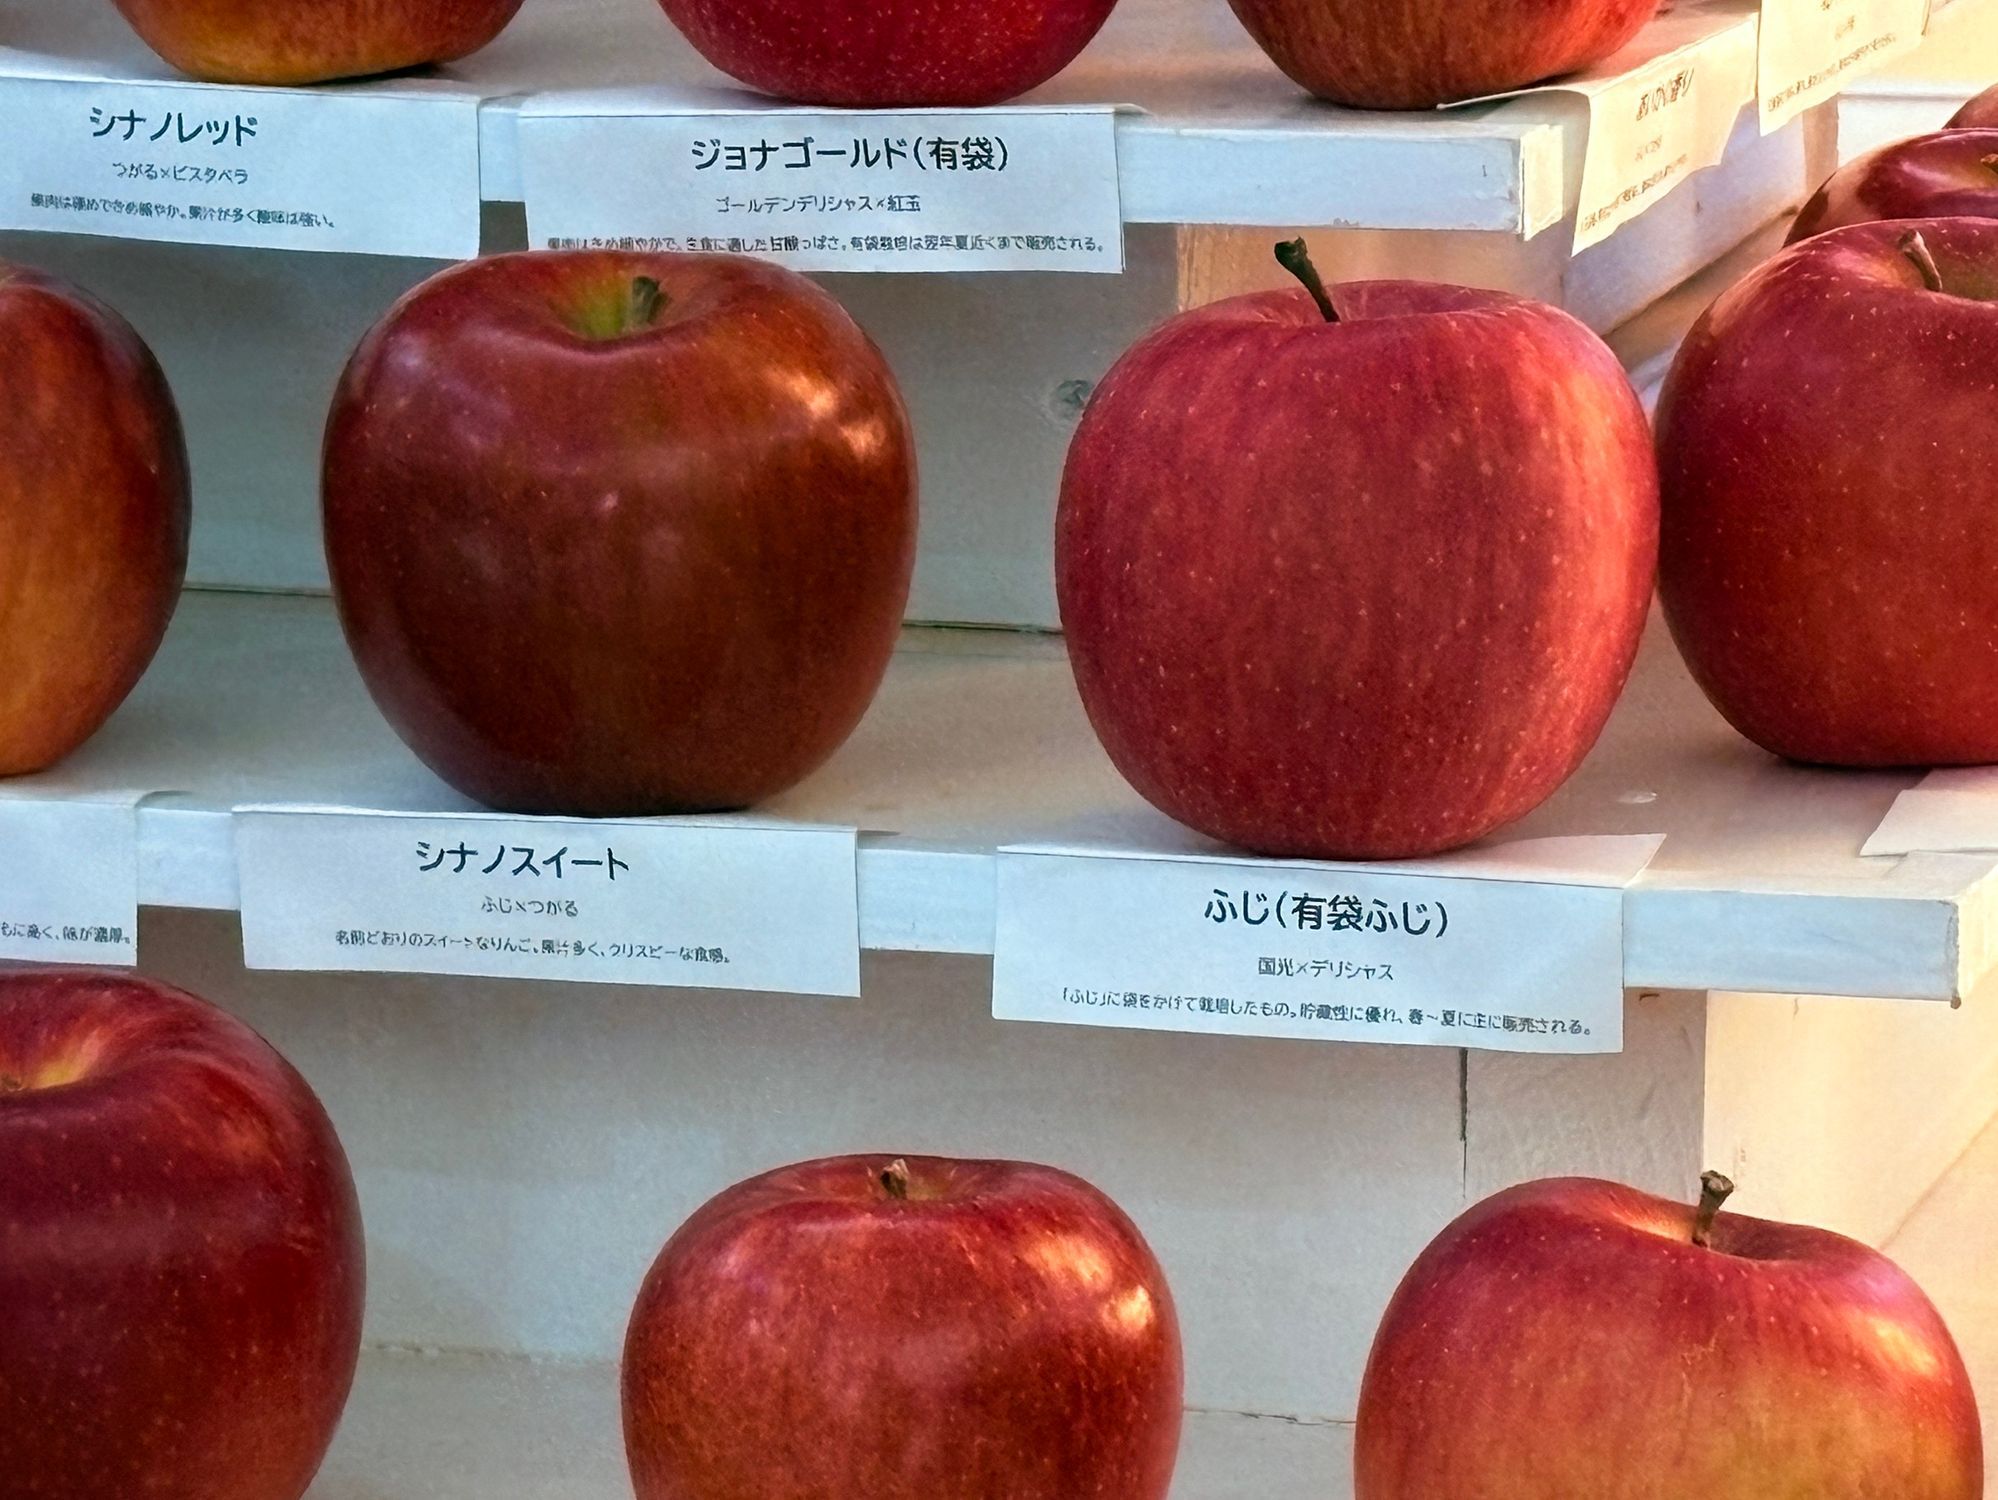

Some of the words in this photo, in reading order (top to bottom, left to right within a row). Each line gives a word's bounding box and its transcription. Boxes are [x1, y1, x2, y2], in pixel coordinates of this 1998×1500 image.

[88, 107, 258, 148] シナノレッド
[716, 194, 921, 215] ゴールデンデリシャス×紅玉
[416, 841, 630, 882] シナノスイート
[480, 896, 579, 917] ふじ×つがる
[1204, 889, 1449, 939] ふじ(有袋ふじ)
[1257, 957, 1394, 981] 国光×デリシャス
